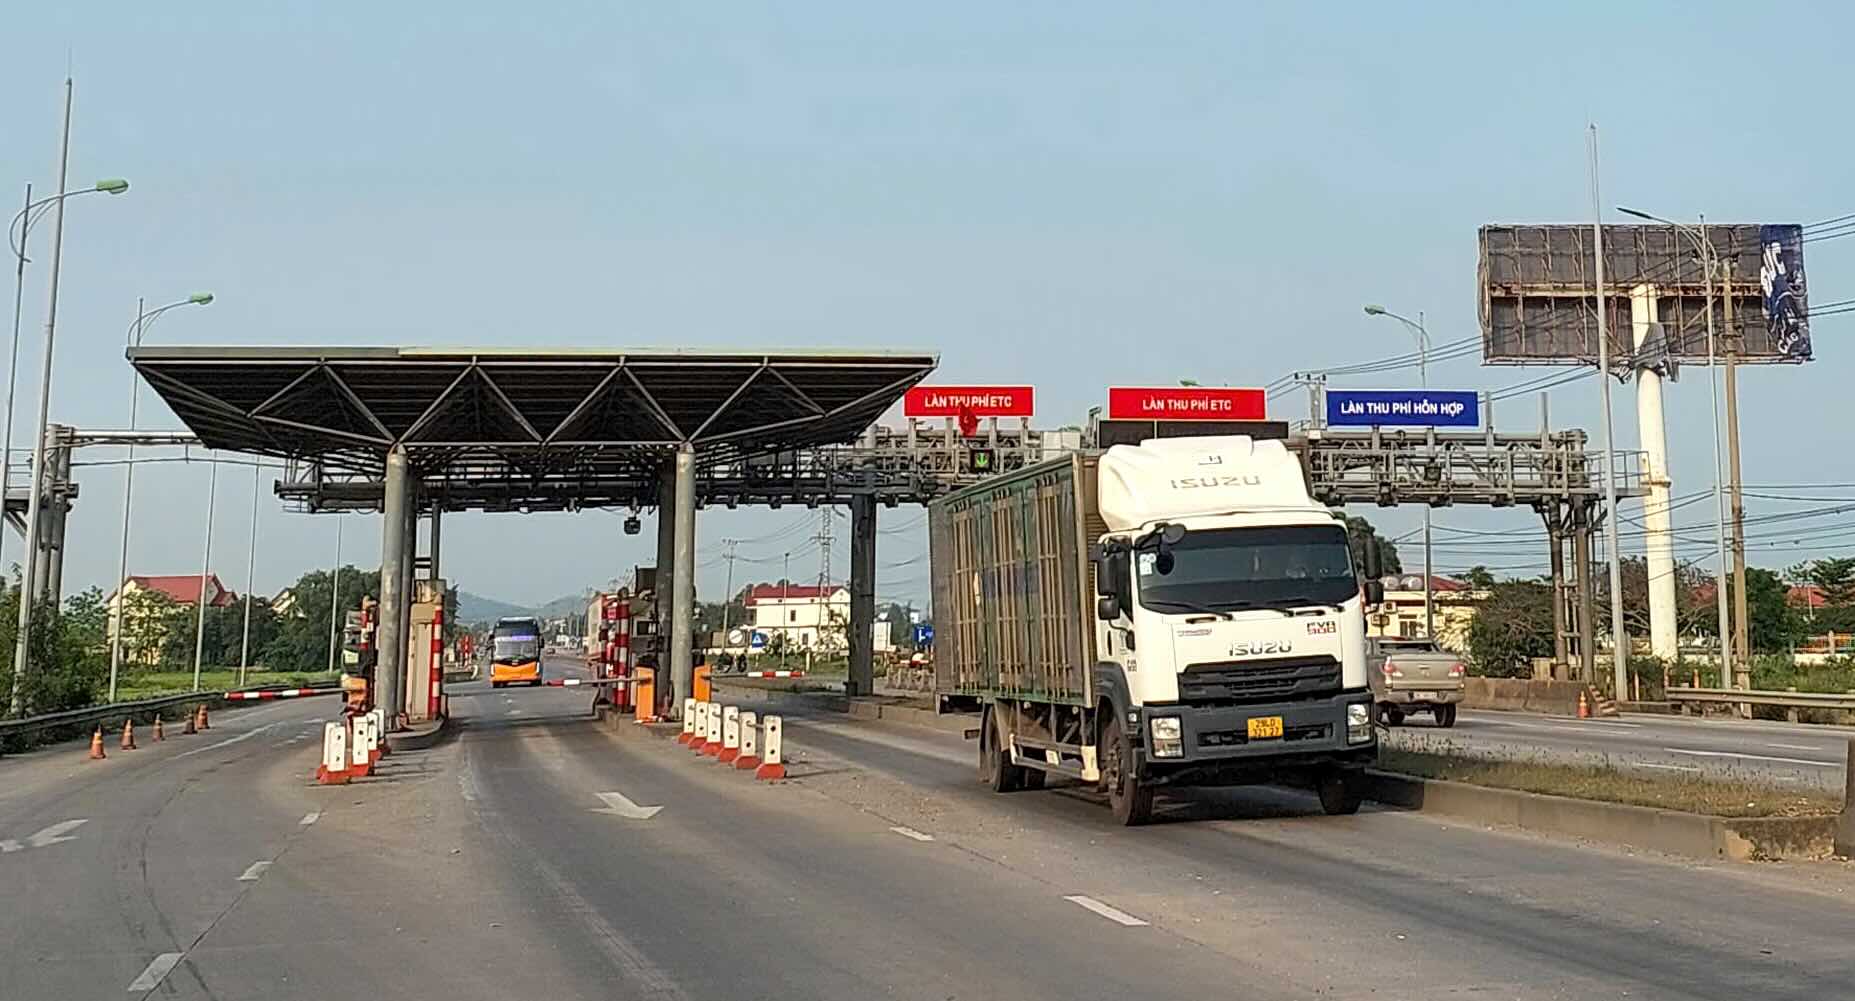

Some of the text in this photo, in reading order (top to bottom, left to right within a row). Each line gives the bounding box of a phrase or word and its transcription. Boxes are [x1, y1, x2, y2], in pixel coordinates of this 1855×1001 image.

[925, 393, 1012, 408] LÀN THU PHÍ ETC
[1142, 396, 1232, 410] LÀN THU PHÍ ETC
[1340, 399, 1465, 417] LÀN THU PHÍ HỖN HỢP
[1170, 475, 1261, 489] ISUZU
[1229, 639, 1292, 657] ISUZU
